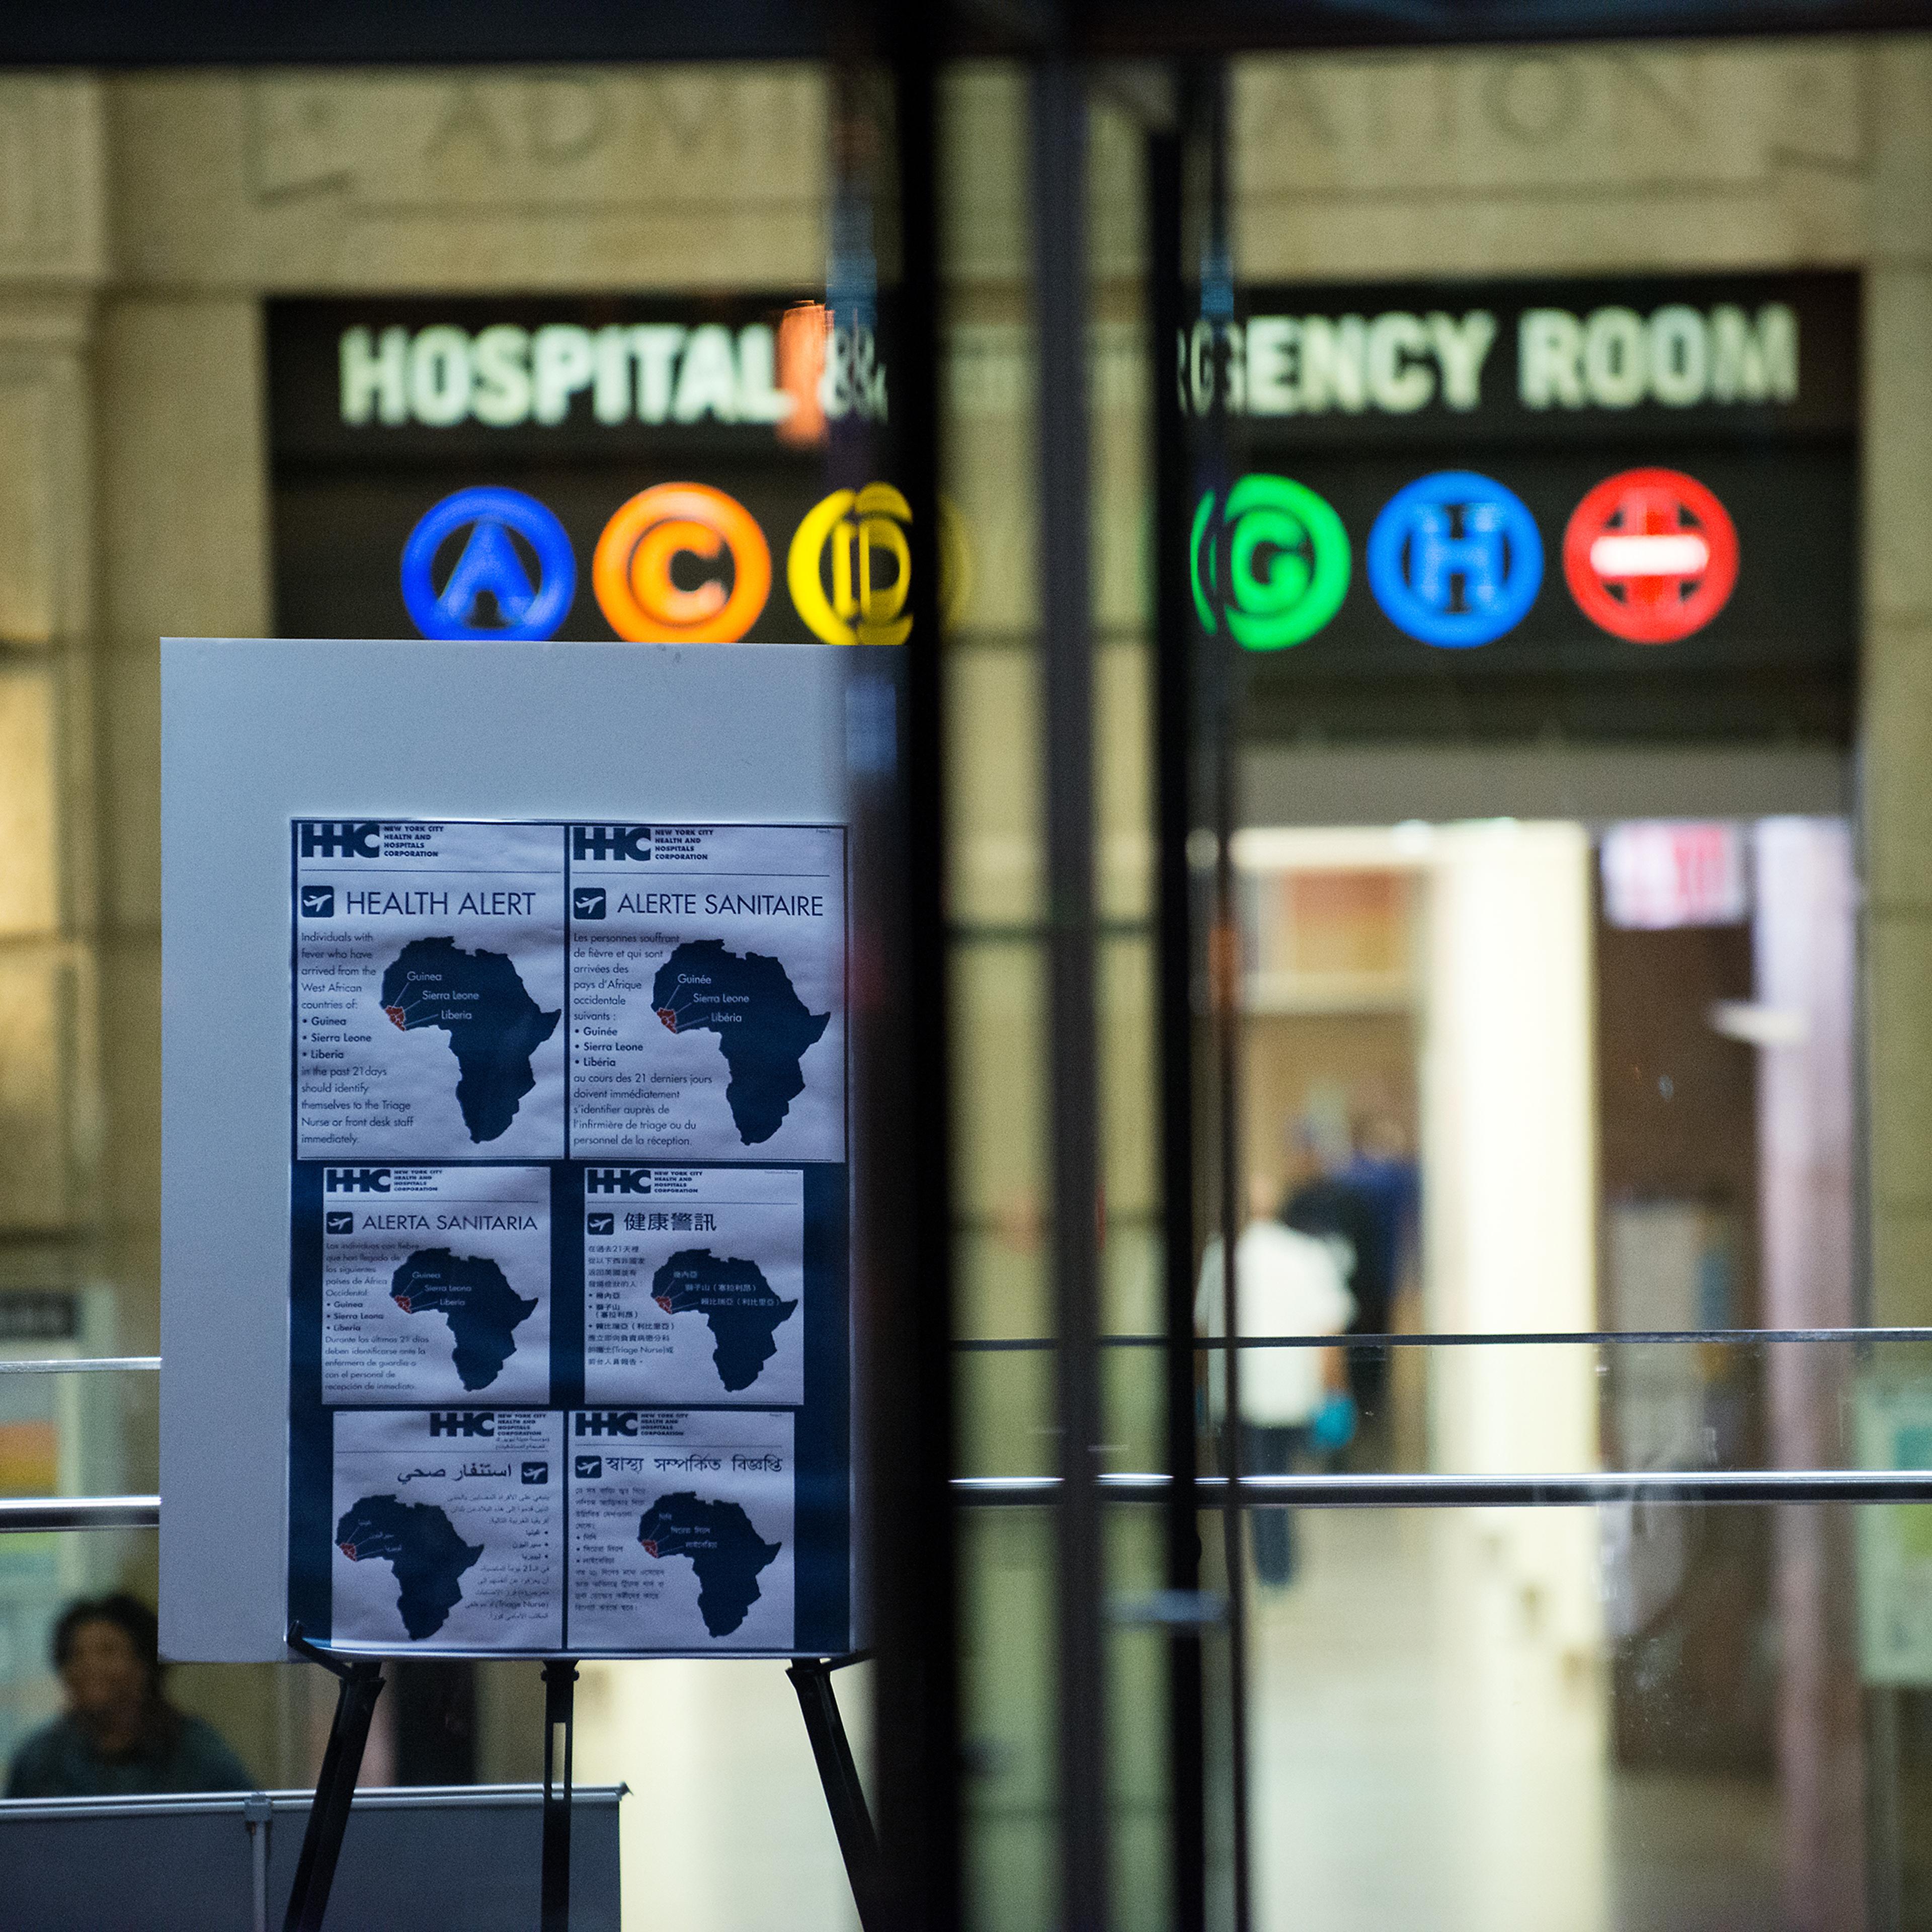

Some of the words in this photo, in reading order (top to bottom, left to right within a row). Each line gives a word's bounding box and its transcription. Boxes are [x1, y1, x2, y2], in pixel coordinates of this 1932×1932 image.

[338, 323, 795, 426] HOSPITAL
[1517, 304, 1800, 411] ROOM
[437, 518, 542, 625] A
[629, 518, 728, 628] C
[1411, 502, 1505, 613] H
[302, 824, 380, 858] HHC
[574, 826, 652, 861] HHC
[347, 891, 448, 915] HEALTH
[457, 892, 536, 915] ALERT
[617, 893, 696, 914] ALERTE
[705, 894, 823, 916] SANITAIRE
[301, 931, 352, 942] Individuals
[354, 932, 374, 943] with
[573, 931, 588, 942] Les
[590, 935, 637, 944] personnes
[639, 932, 681, 945] souffrant
[301, 948, 325, 958] fever
[326, 948, 348, 959] who
[350, 948, 373, 959] have
[573, 947, 587, 958] de
[588, 947, 614, 958] fièvre
[615, 949, 625, 958] et
[627, 948, 641, 960] qui
[645, 949, 664, 958] sont
[301, 964, 336, 976] arrived
[337, 964, 359, 976] from
[362, 964, 377, 976] the
[573, 963, 610, 974] arrivées
[612, 963, 629, 974] des
[407, 971, 442, 982] Guinea
[677, 973, 712, 984] Guinée
[300, 983, 326, 993] West
[328, 981, 362, 993] African
[573, 982, 596, 991] pays
[422, 990, 450, 1000] Sierra
[452, 990, 479, 1000] Leone
[573, 995, 626, 1005] occidentale
[693, 993, 720, 1003] Sierra
[722, 993, 750, 1003] Leone
[301, 1000, 343, 1010] countries
[441, 1009, 472, 1020] Liberia
[574, 1011, 610, 1021] suivants
[711, 1012, 742, 1022] Libéria
[310, 1016, 347, 1026] Guinea
[311, 1032, 341, 1042] Sierra
[343, 1033, 372, 1042] Leone
[583, 1026, 618, 1036] Guinée
[584, 1041, 612, 1052] Sierra
[615, 1042, 643, 1052] Leone
[310, 1049, 344, 1059] Liberia
[583, 1056, 616, 1067] Libéria
[312, 1065, 328, 1076] the
[330, 1066, 351, 1078] past
[588, 1075, 613, 1083] cours
[615, 1072, 632, 1083] des
[634, 1073, 646, 1083] 21
[650, 1072, 688, 1083] derniers
[689, 1073, 712, 1085] jours
[301, 1082, 333, 1093] should
[335, 1082, 370, 1095] identify
[573, 1088, 608, 1099] doivent
[610, 1088, 680, 1099] immédiatement
[301, 1099, 351, 1110] themselves
[353, 1101, 363, 1110] to
[364, 1098, 379, 1110] the
[382, 1099, 411, 1112] Triage
[623, 1104, 656, 1116] auprès
[658, 1103, 670, 1114] de
[301, 1117, 331, 1126] Nurse
[345, 1115, 368, 1126] front
[369, 1116, 391, 1126] desk
[393, 1115, 414, 1126] staff
[625, 1119, 637, 1130] de
[639, 1119, 668, 1132] triage
[684, 1119, 697, 1130] du
[573, 1135, 618, 1148] personnel
[620, 1135, 633, 1145] de
[635, 1135, 645, 1146] la
[328, 1168, 391, 1192] HHC
[588, 1169, 652, 1194] HHC
[362, 1215, 430, 1230] ALERTA
[436, 1214, 538, 1230] SANITARIA
[623, 1212, 717, 1231] 健康警訊
[431, 1412, 495, 1437] HHC
[576, 1412, 638, 1436] HHC
[397, 1468, 446, 1483] صحي
